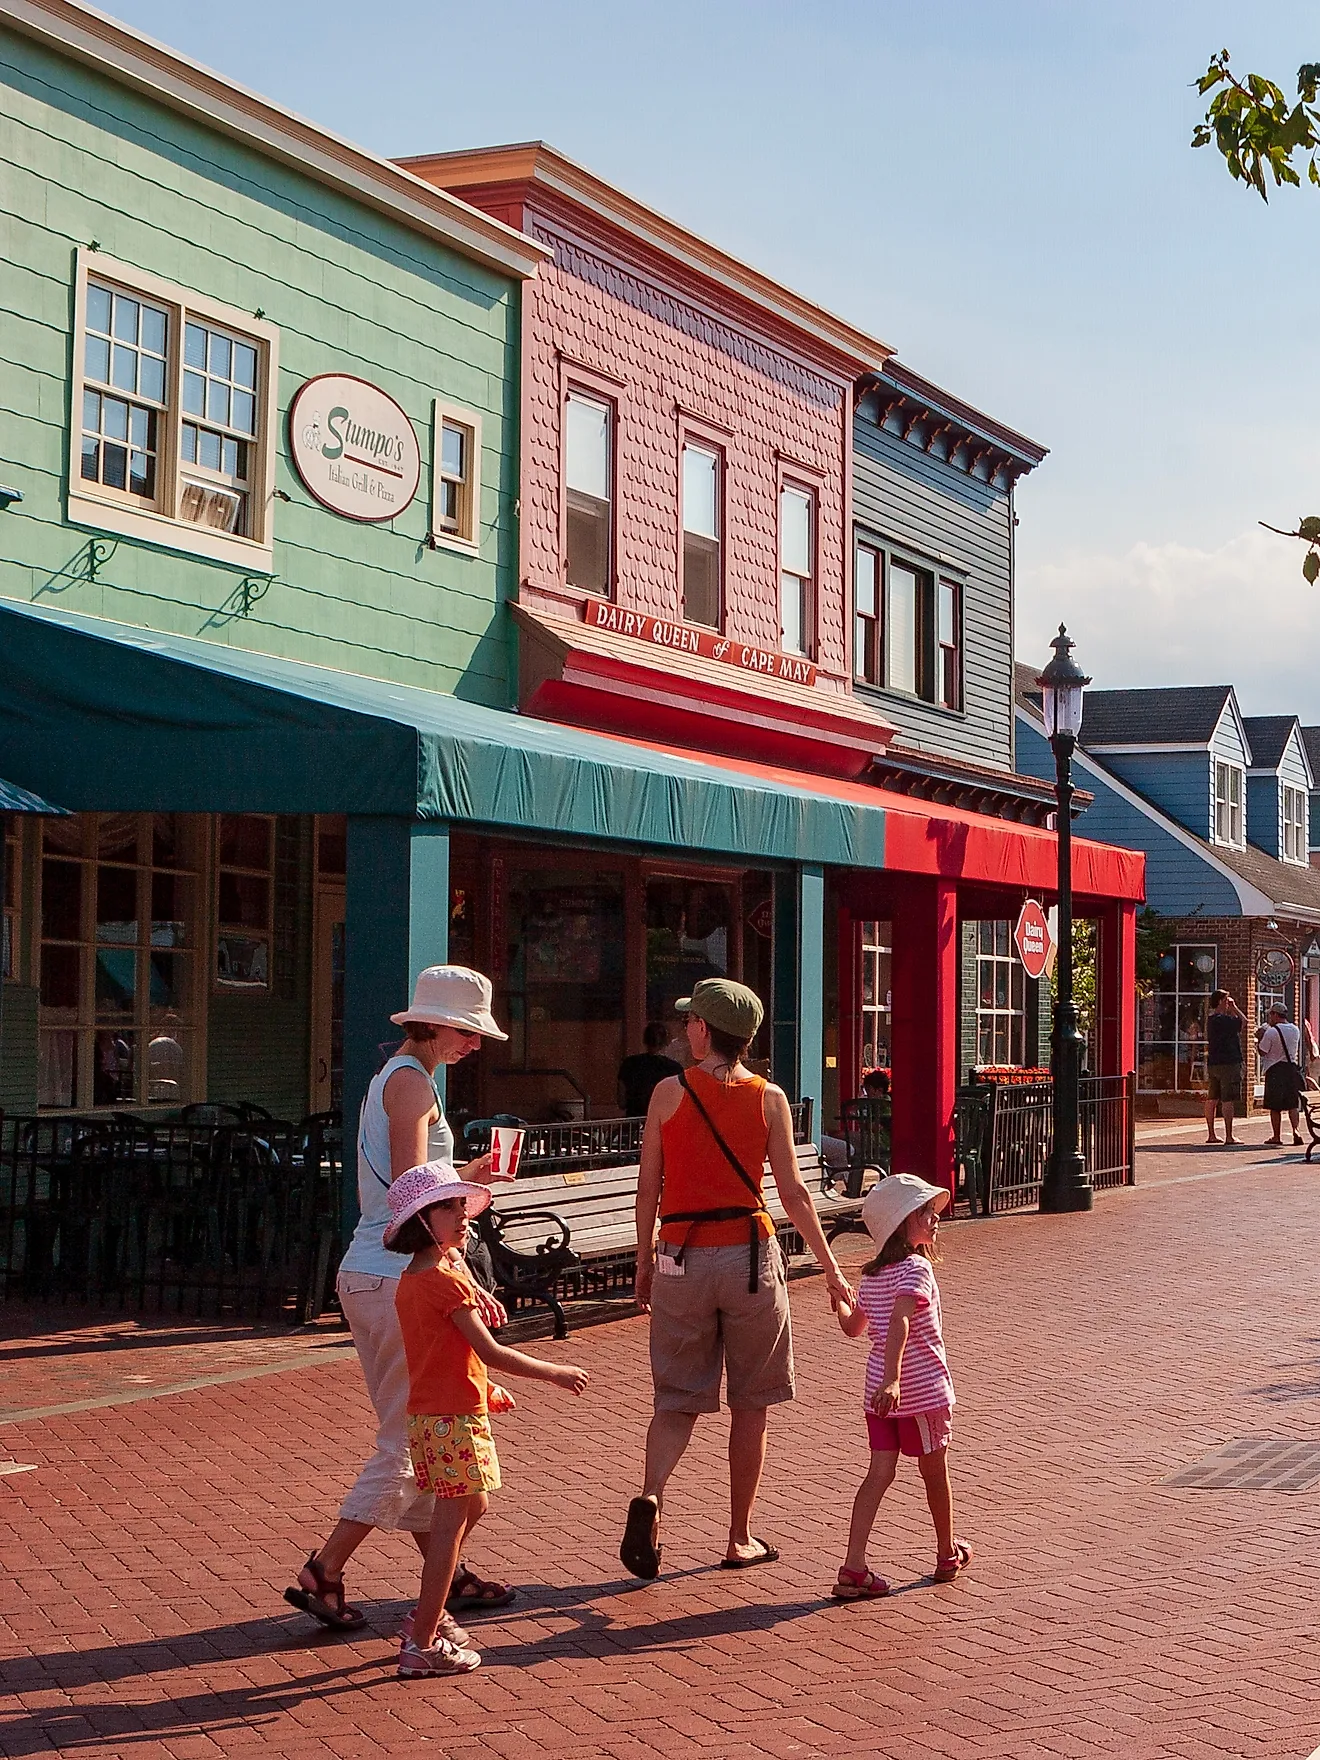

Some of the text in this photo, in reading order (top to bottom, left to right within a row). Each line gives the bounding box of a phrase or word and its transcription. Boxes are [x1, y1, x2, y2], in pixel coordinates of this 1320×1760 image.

[321, 406, 404, 462] Stumpo's
[328, 464, 350, 488] Italian
[351, 472, 369, 494] Grill
[377, 481, 395, 503] Pizza
[596, 603, 811, 683] DAIRY QUEEN of CAPE MAY
[1023, 936, 1044, 955] Queen
[1025, 920, 1043, 941] Dairy
